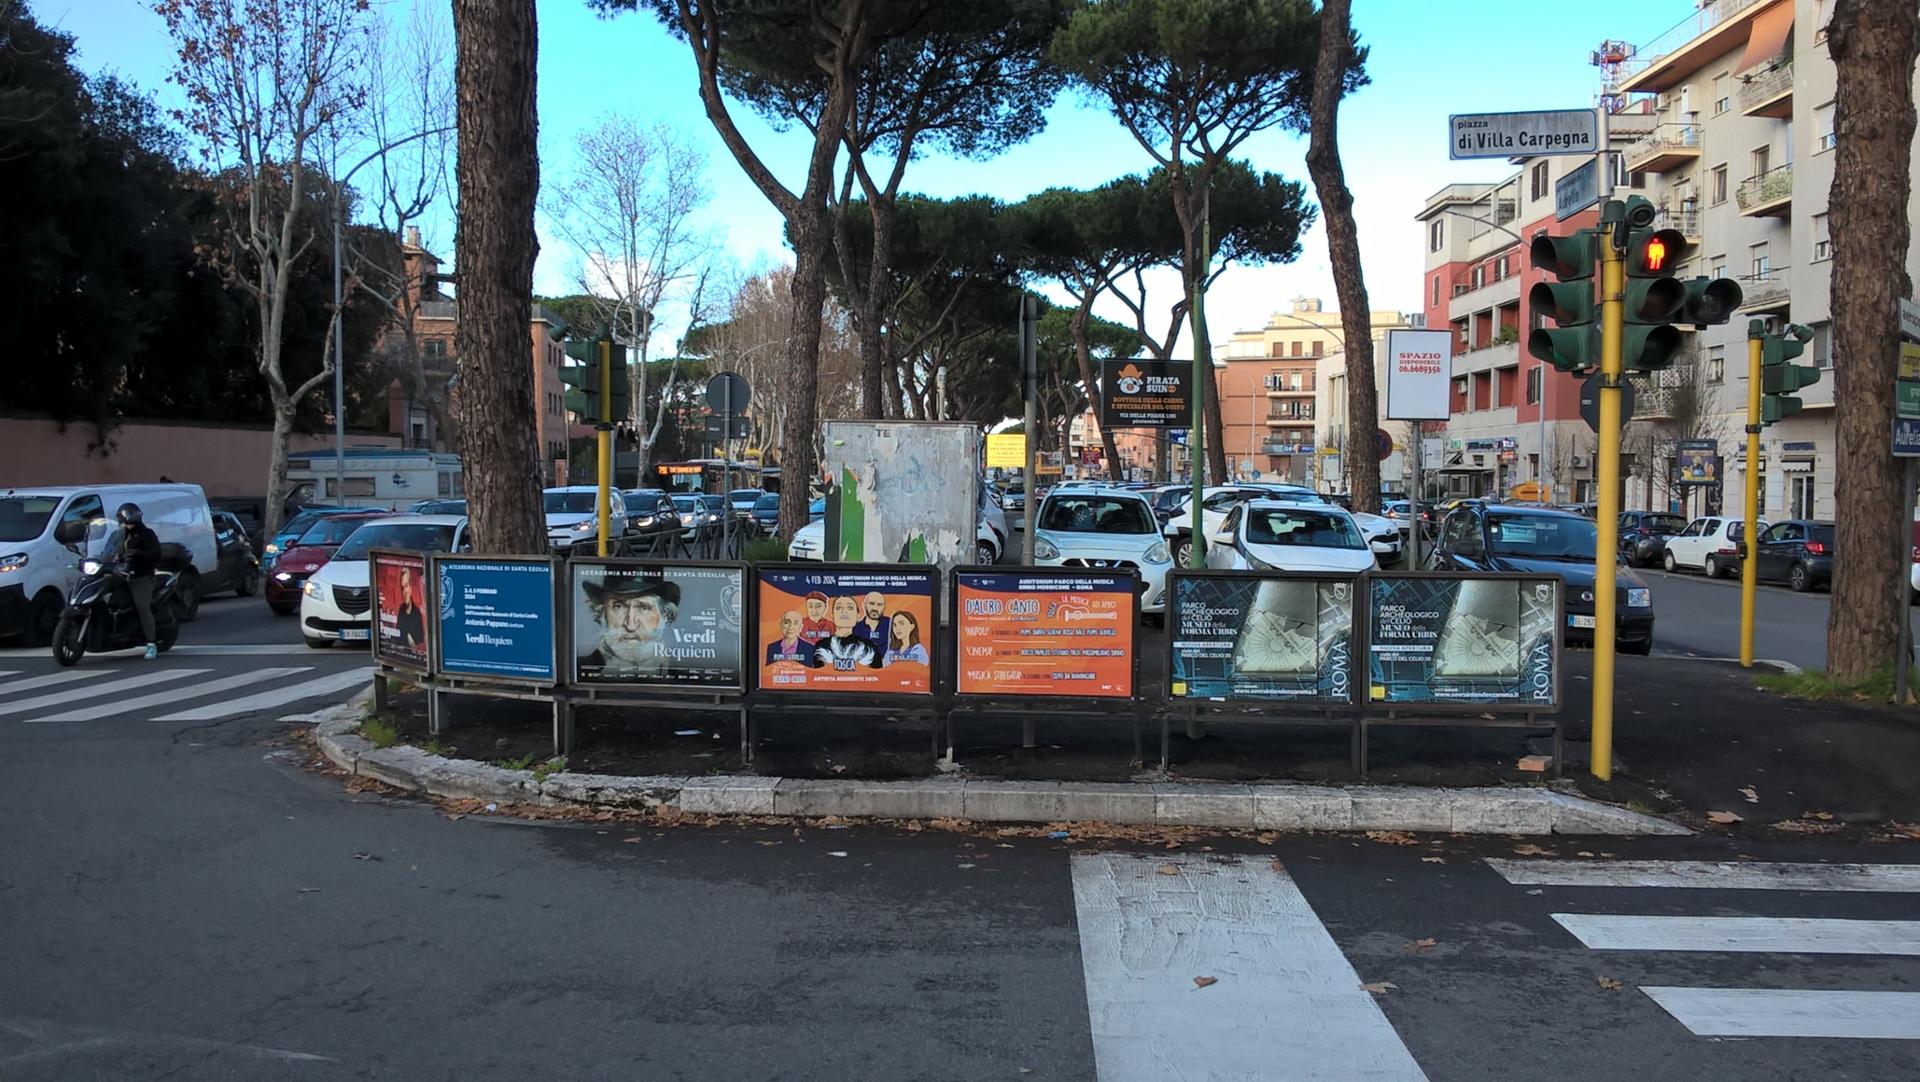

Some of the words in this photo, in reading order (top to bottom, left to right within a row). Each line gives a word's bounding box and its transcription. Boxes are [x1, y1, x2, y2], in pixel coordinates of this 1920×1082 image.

[1457, 120, 1488, 130] piazza
[1458, 134, 1472, 149] di
[1476, 132, 1514, 148] Villa
[1518, 131, 1589, 149] Carpegna
[1146, 376, 1180, 385] PIRATA
[806, 576, 811, 585] 4
[812, 576, 822, 585] FEB
[822, 576, 836, 585] 2024
[965, 599, 1002, 615] D'ALTRO
[1006, 599, 1040, 615] CANTO
[465, 633, 484, 643] Verdi
[485, 634, 513, 647] Requiem
[673, 628, 716, 643] Verdi
[654, 643, 716, 661] Requiem
[833, 658, 857, 671] TOSCA
[1331, 641, 1347, 697] ROMA
[1533, 643, 1549, 700] ROMA
